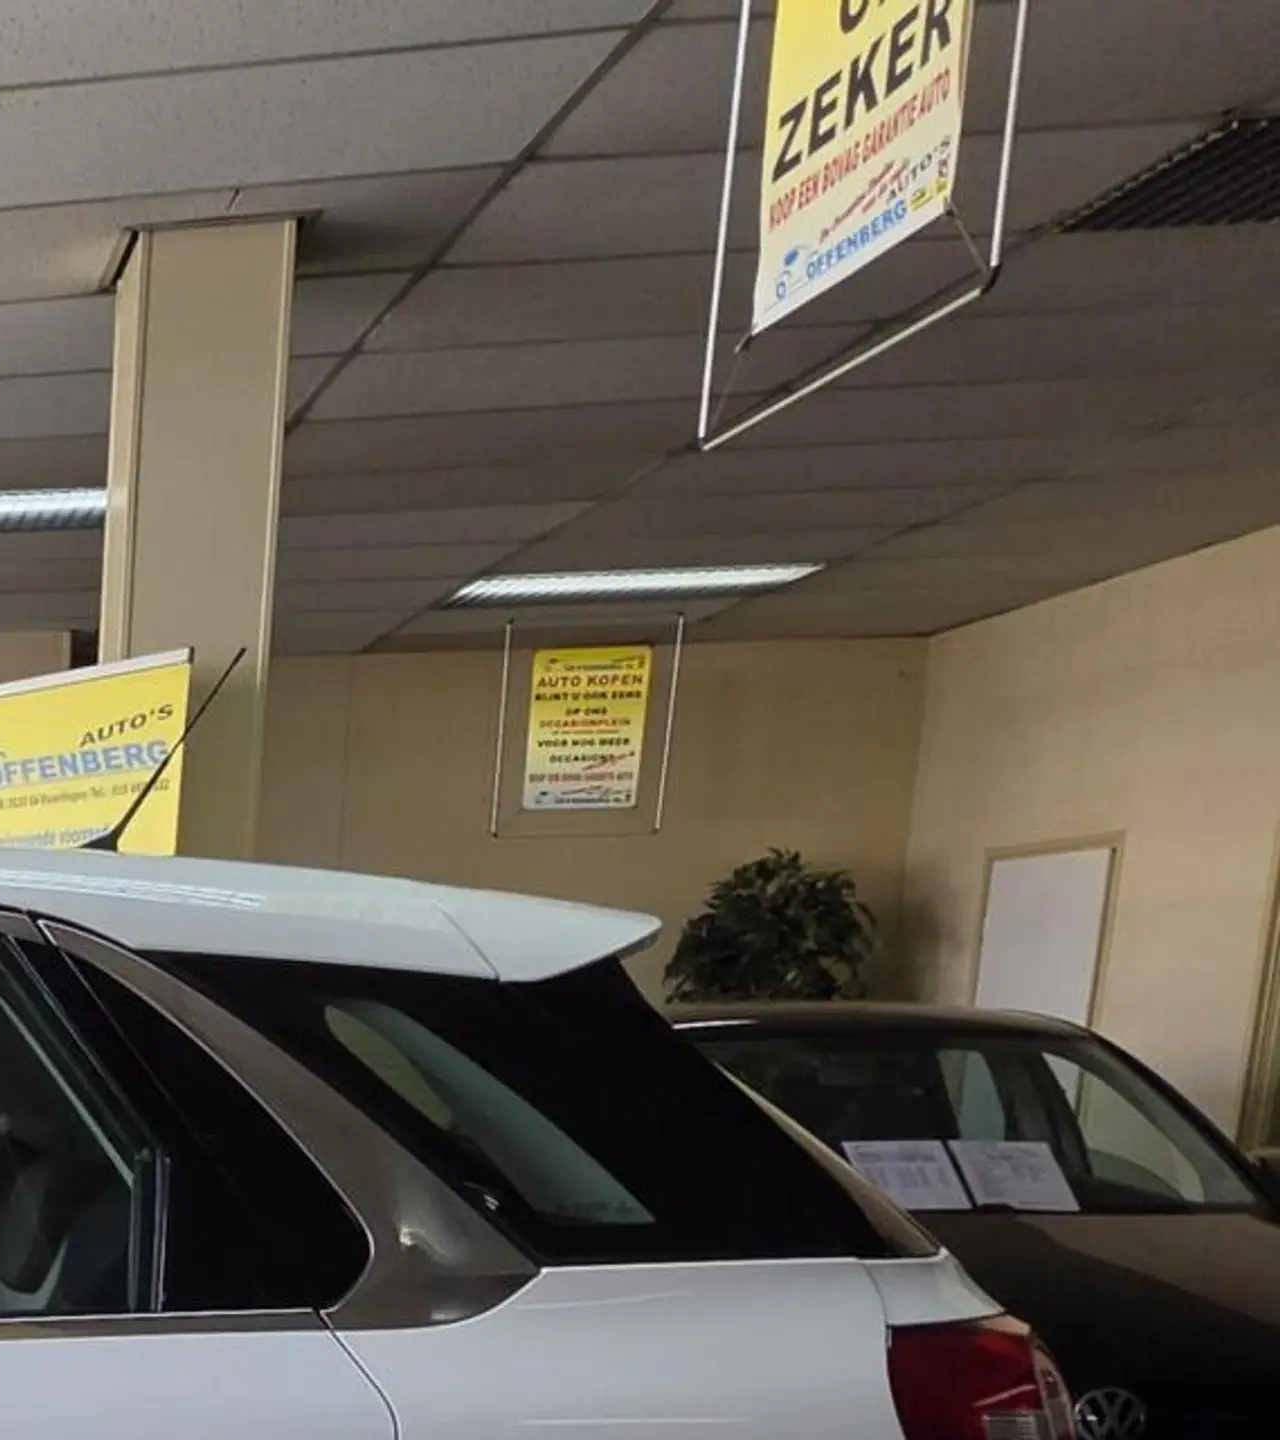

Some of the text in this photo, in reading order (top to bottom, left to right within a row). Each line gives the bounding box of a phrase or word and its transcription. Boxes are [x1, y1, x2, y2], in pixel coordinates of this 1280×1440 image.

[772, 0, 951, 184] ZEKER
[805, 200, 908, 282] OFFENBERG
[538, 671, 643, 689] AUTO KOPEN
[78, 702, 175, 749] AUTO'S
